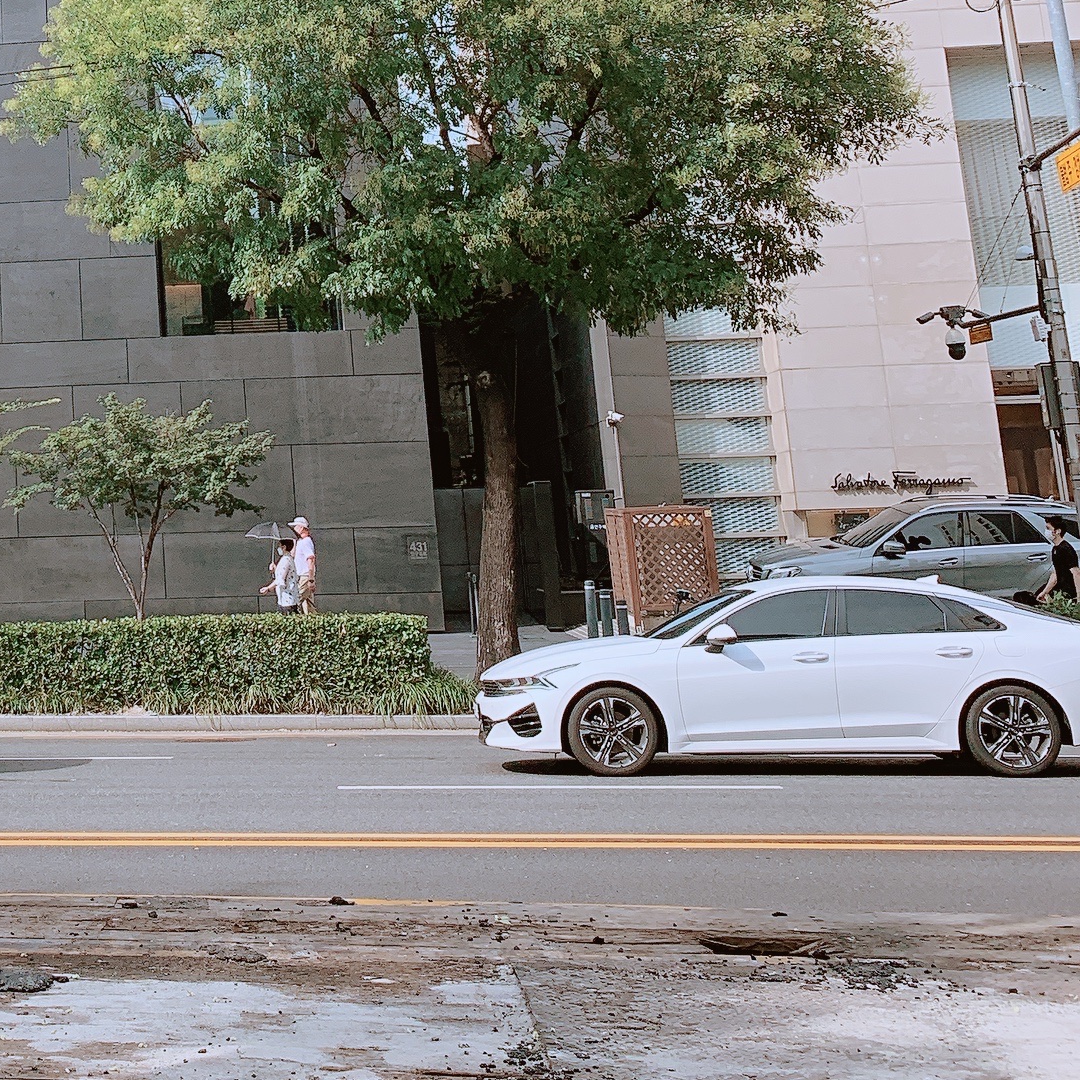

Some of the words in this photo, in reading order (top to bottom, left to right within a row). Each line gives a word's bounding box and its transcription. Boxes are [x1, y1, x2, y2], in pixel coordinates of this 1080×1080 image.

[830, 472, 890, 489] Salvatore
[892, 471, 971, 495] Ferragamo
[409, 541, 428, 552] 431
